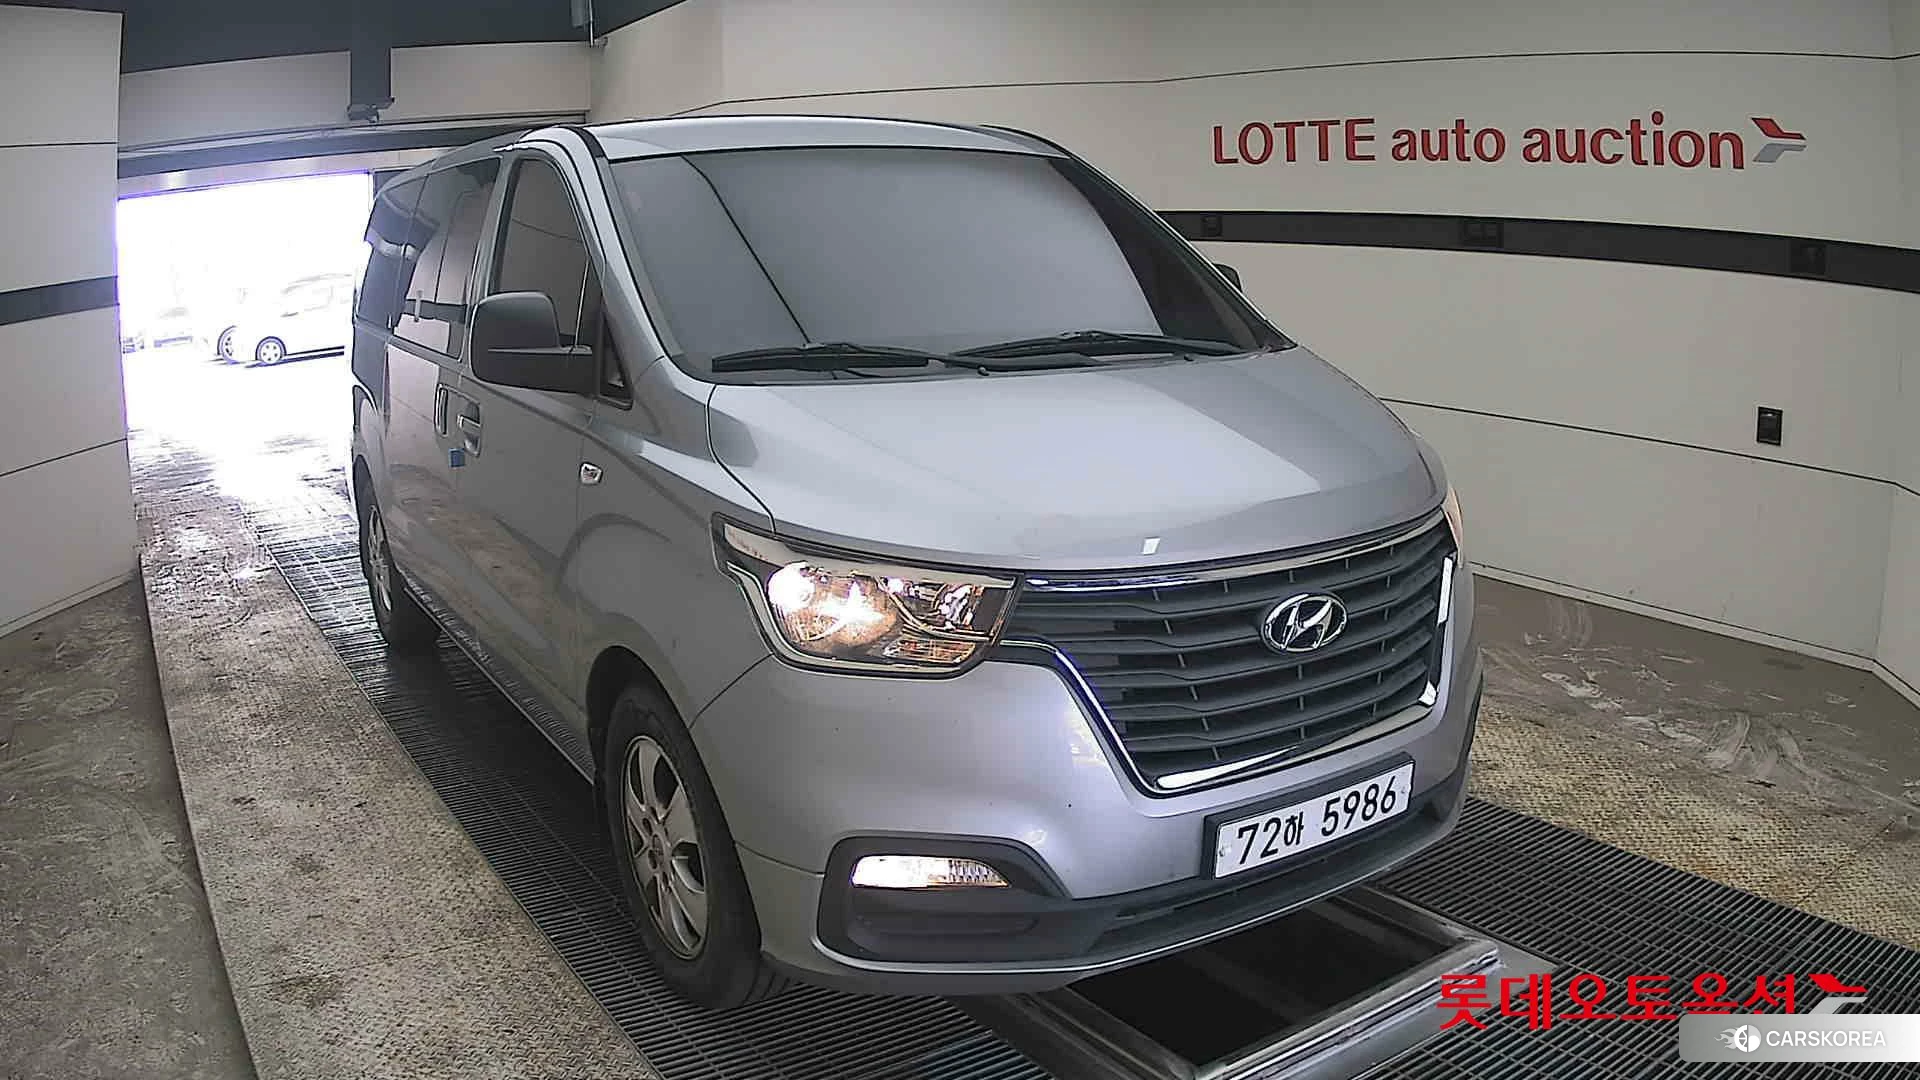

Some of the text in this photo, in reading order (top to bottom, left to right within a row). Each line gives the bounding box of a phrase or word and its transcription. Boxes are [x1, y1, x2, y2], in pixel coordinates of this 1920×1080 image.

[1212, 110, 1745, 170] LOTTE auto auction
[1237, 775, 1397, 865] 72하 5986
